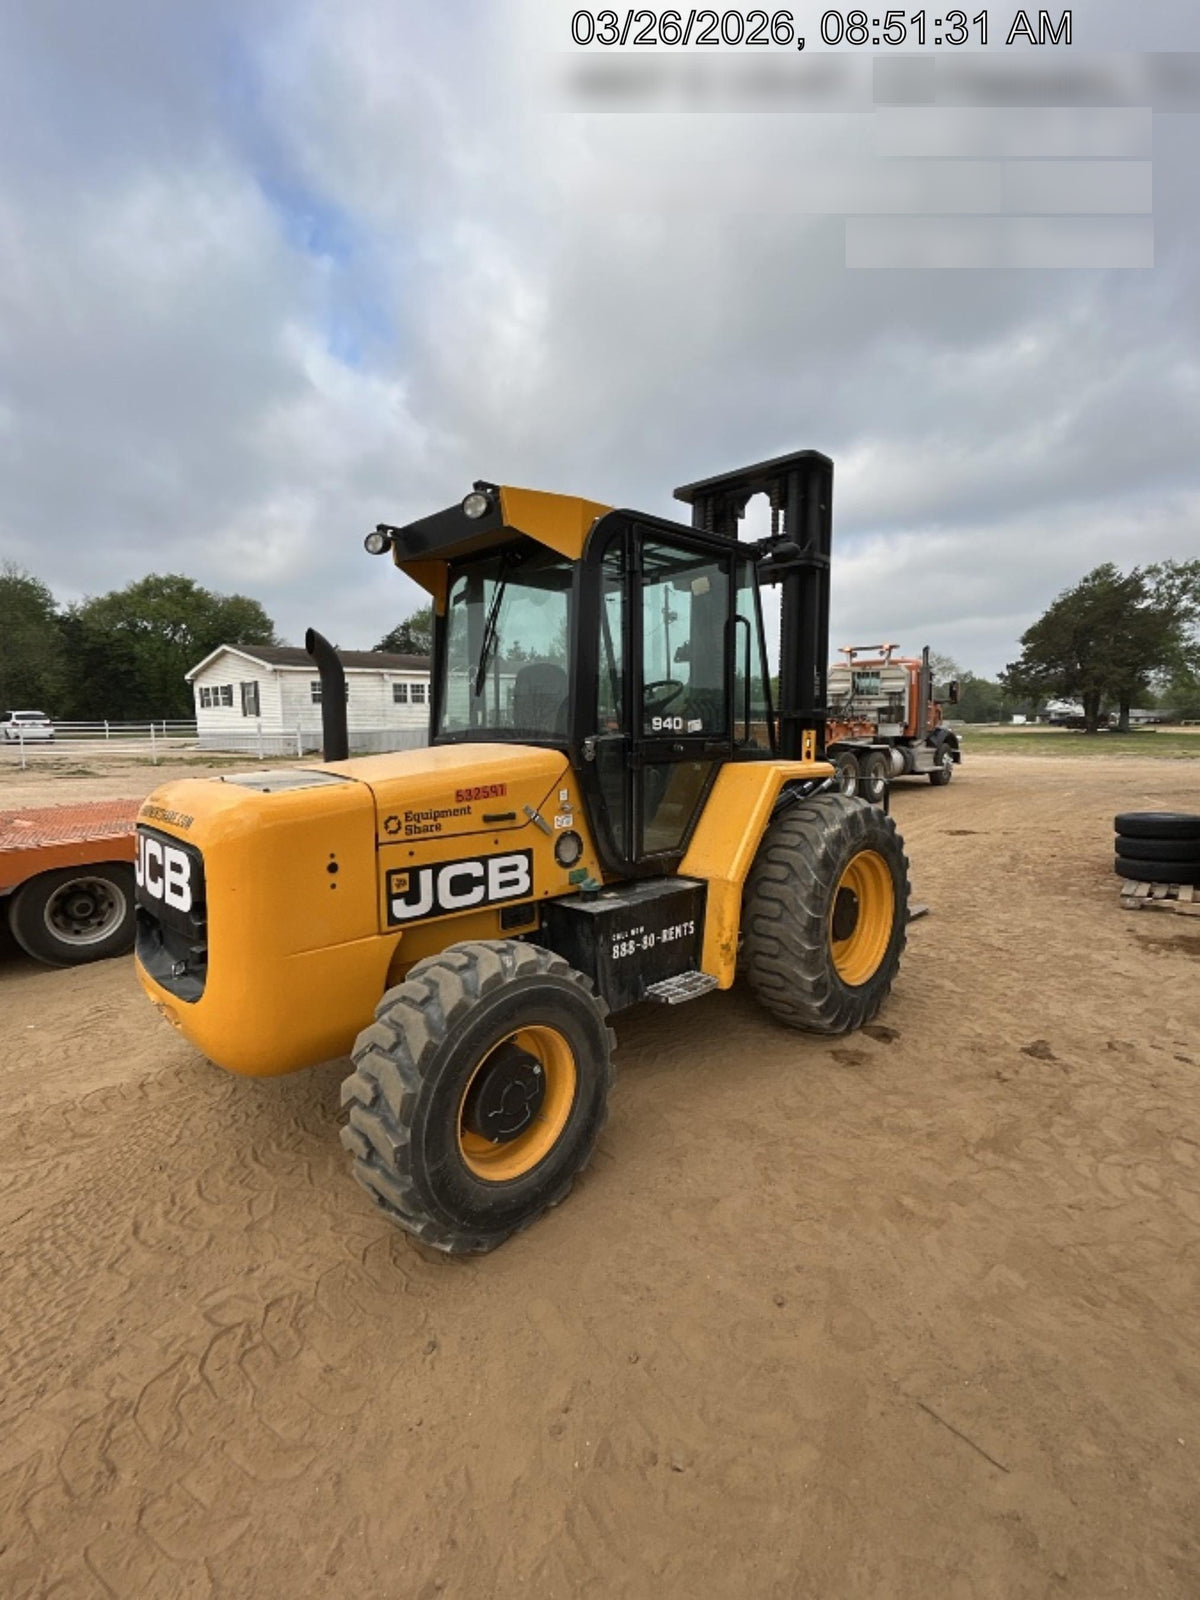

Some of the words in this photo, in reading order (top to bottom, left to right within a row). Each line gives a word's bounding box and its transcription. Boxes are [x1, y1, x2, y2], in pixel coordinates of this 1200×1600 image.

[651, 716, 683, 731] 940
[404, 806, 472, 823] Equipment
[404, 823, 442, 836] Share
[135, 834, 192, 913] JCB
[391, 854, 531, 919] JCB
